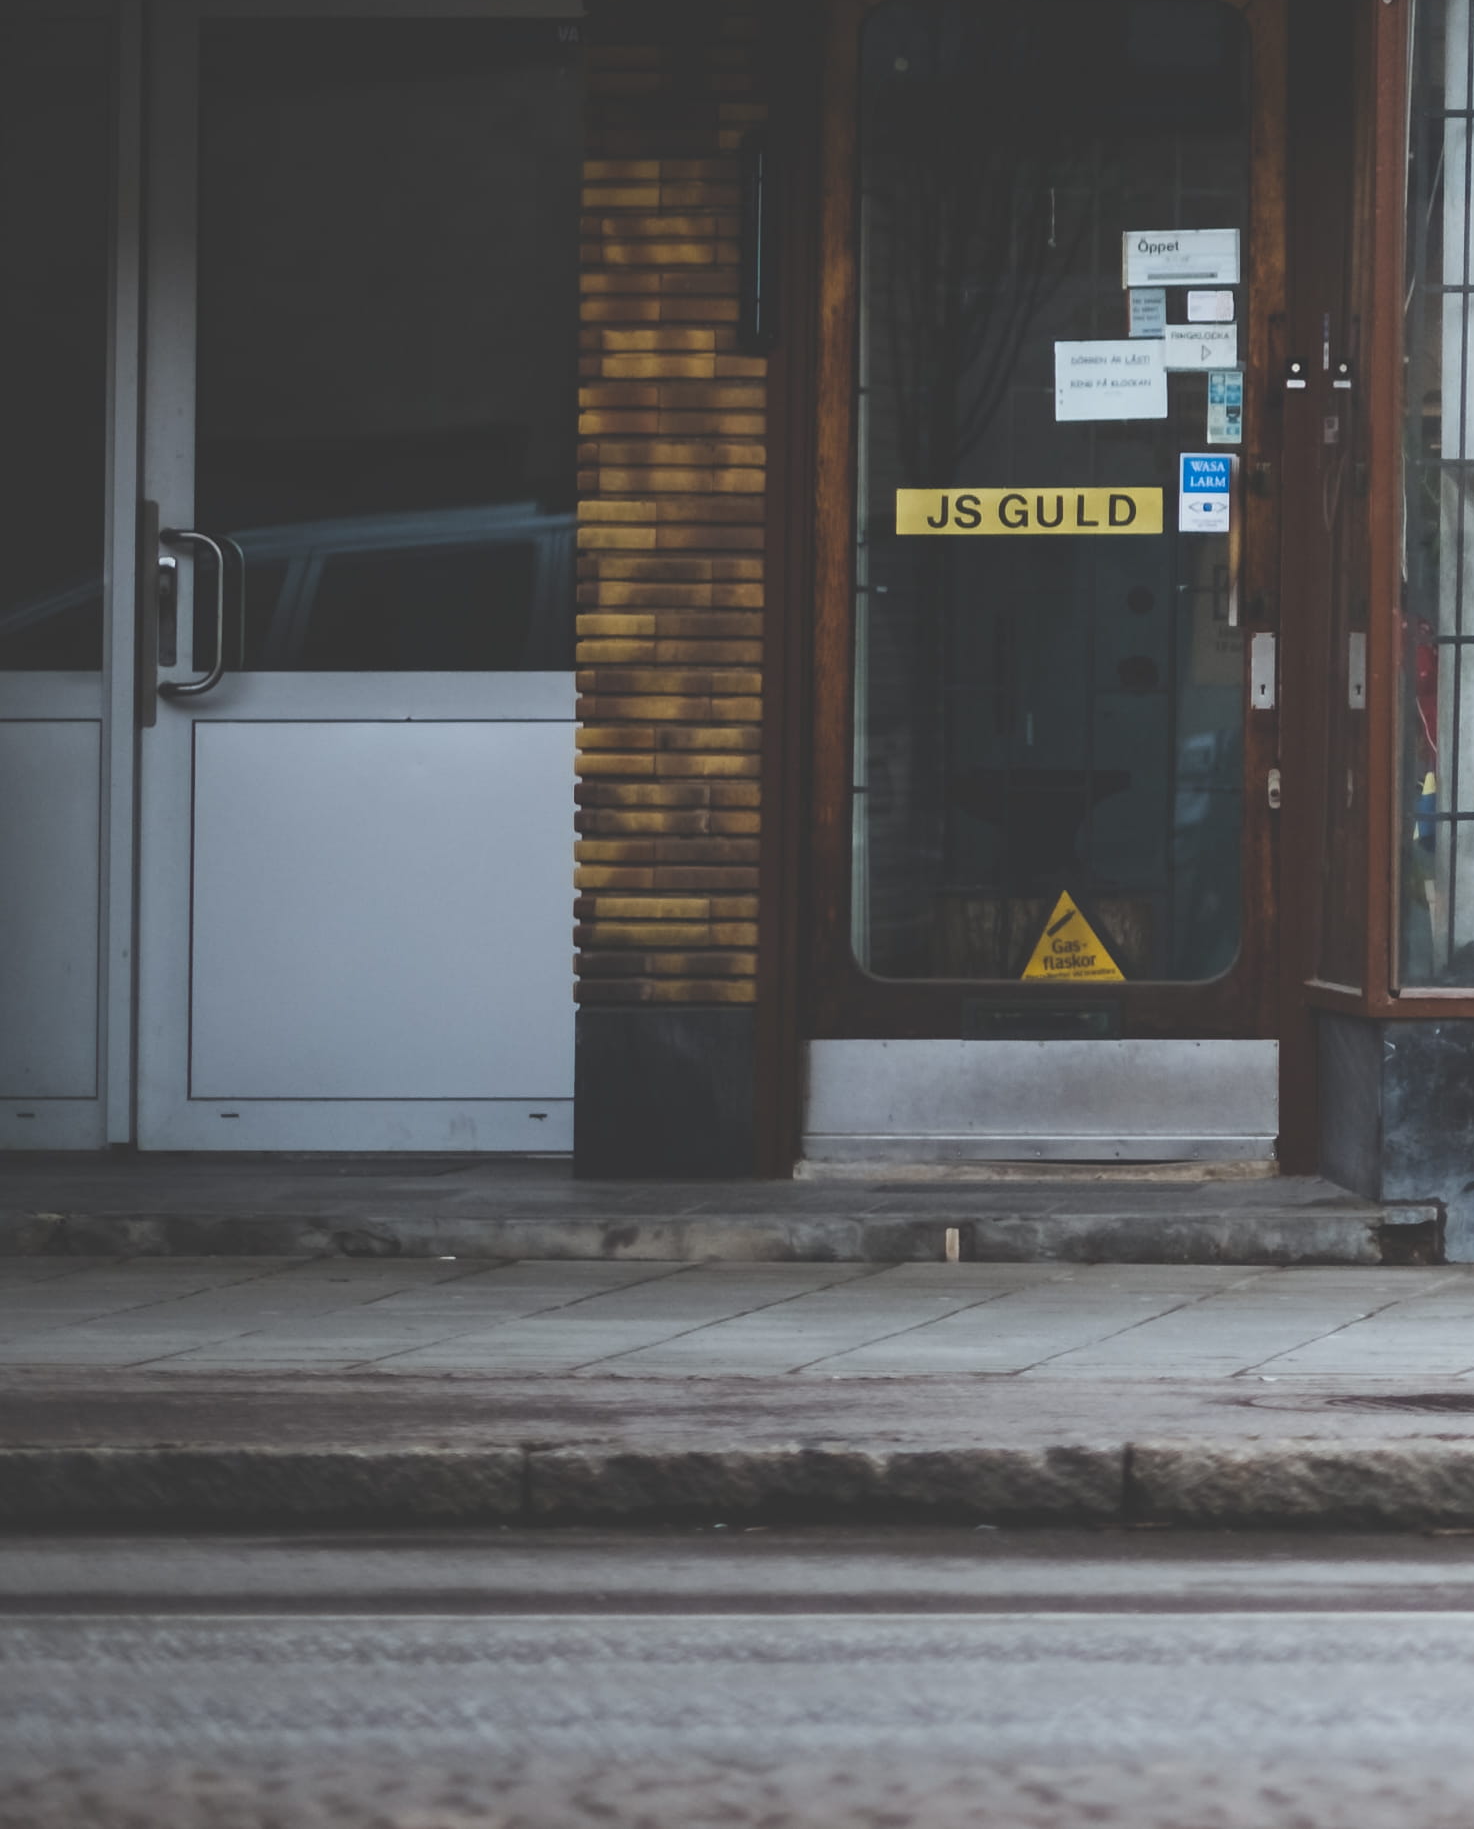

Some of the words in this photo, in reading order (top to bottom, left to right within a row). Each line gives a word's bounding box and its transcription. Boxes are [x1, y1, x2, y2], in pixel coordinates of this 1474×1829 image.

[1137, 237, 1180, 255] Öppet
[1189, 460, 1226, 473] WASA
[1189, 475, 1227, 488] LARM
[926, 493, 982, 529] JS
[998, 493, 1137, 528] GULD
[1051, 938, 1089, 955] Gas-
[1042, 953, 1097, 971] flaskor
